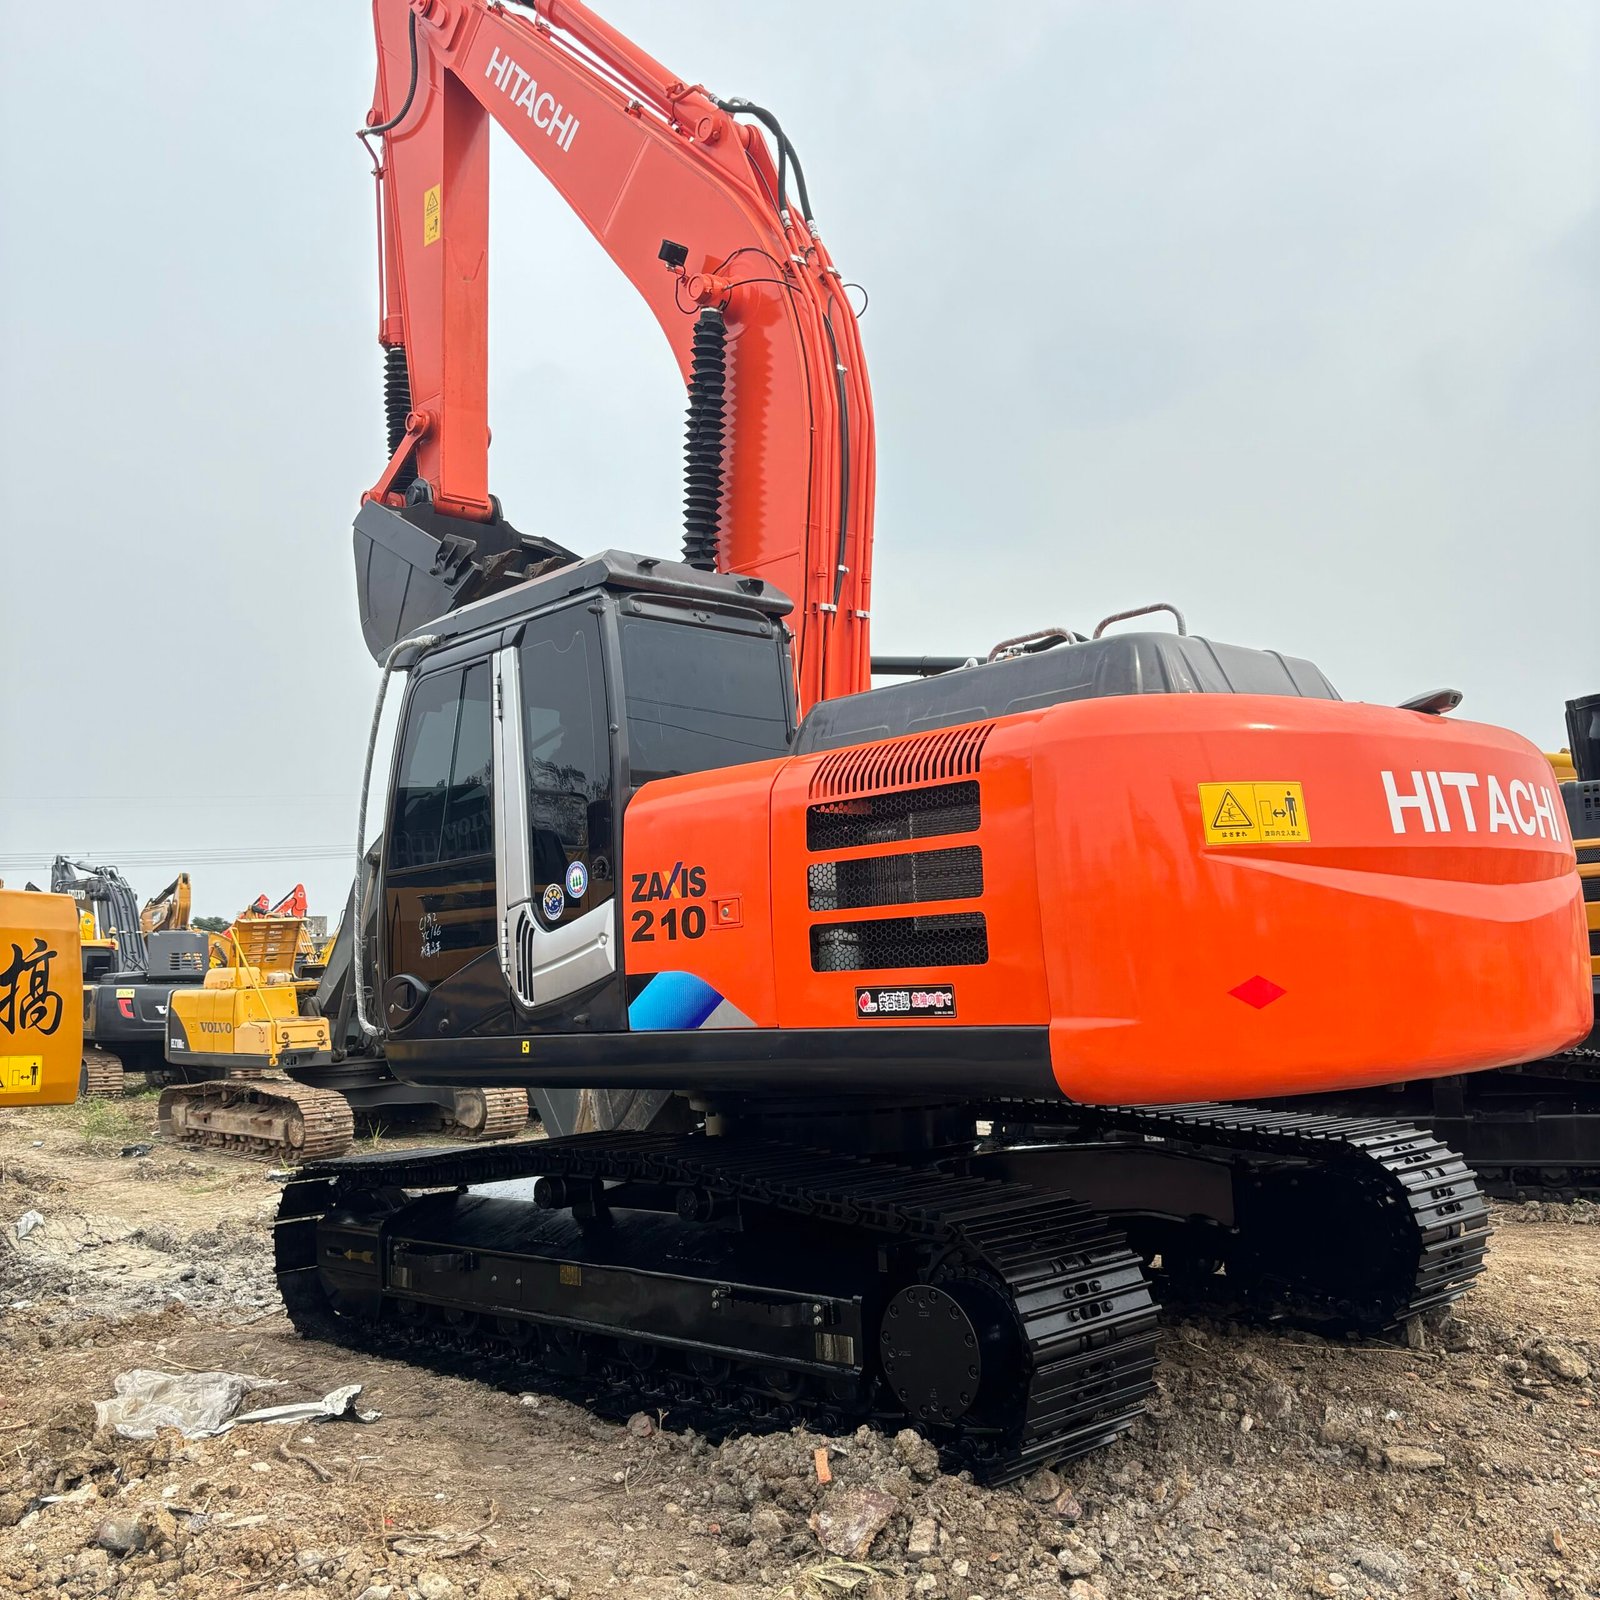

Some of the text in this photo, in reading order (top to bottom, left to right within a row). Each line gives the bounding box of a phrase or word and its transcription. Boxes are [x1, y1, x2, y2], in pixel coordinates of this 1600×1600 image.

[484, 46, 580, 153] HITACHI
[1380, 770, 1562, 843] HITACHI
[631, 861, 707, 903] ZAXIS
[631, 905, 707, 942] 210
[199, 1021, 232, 1033] VOLVO
